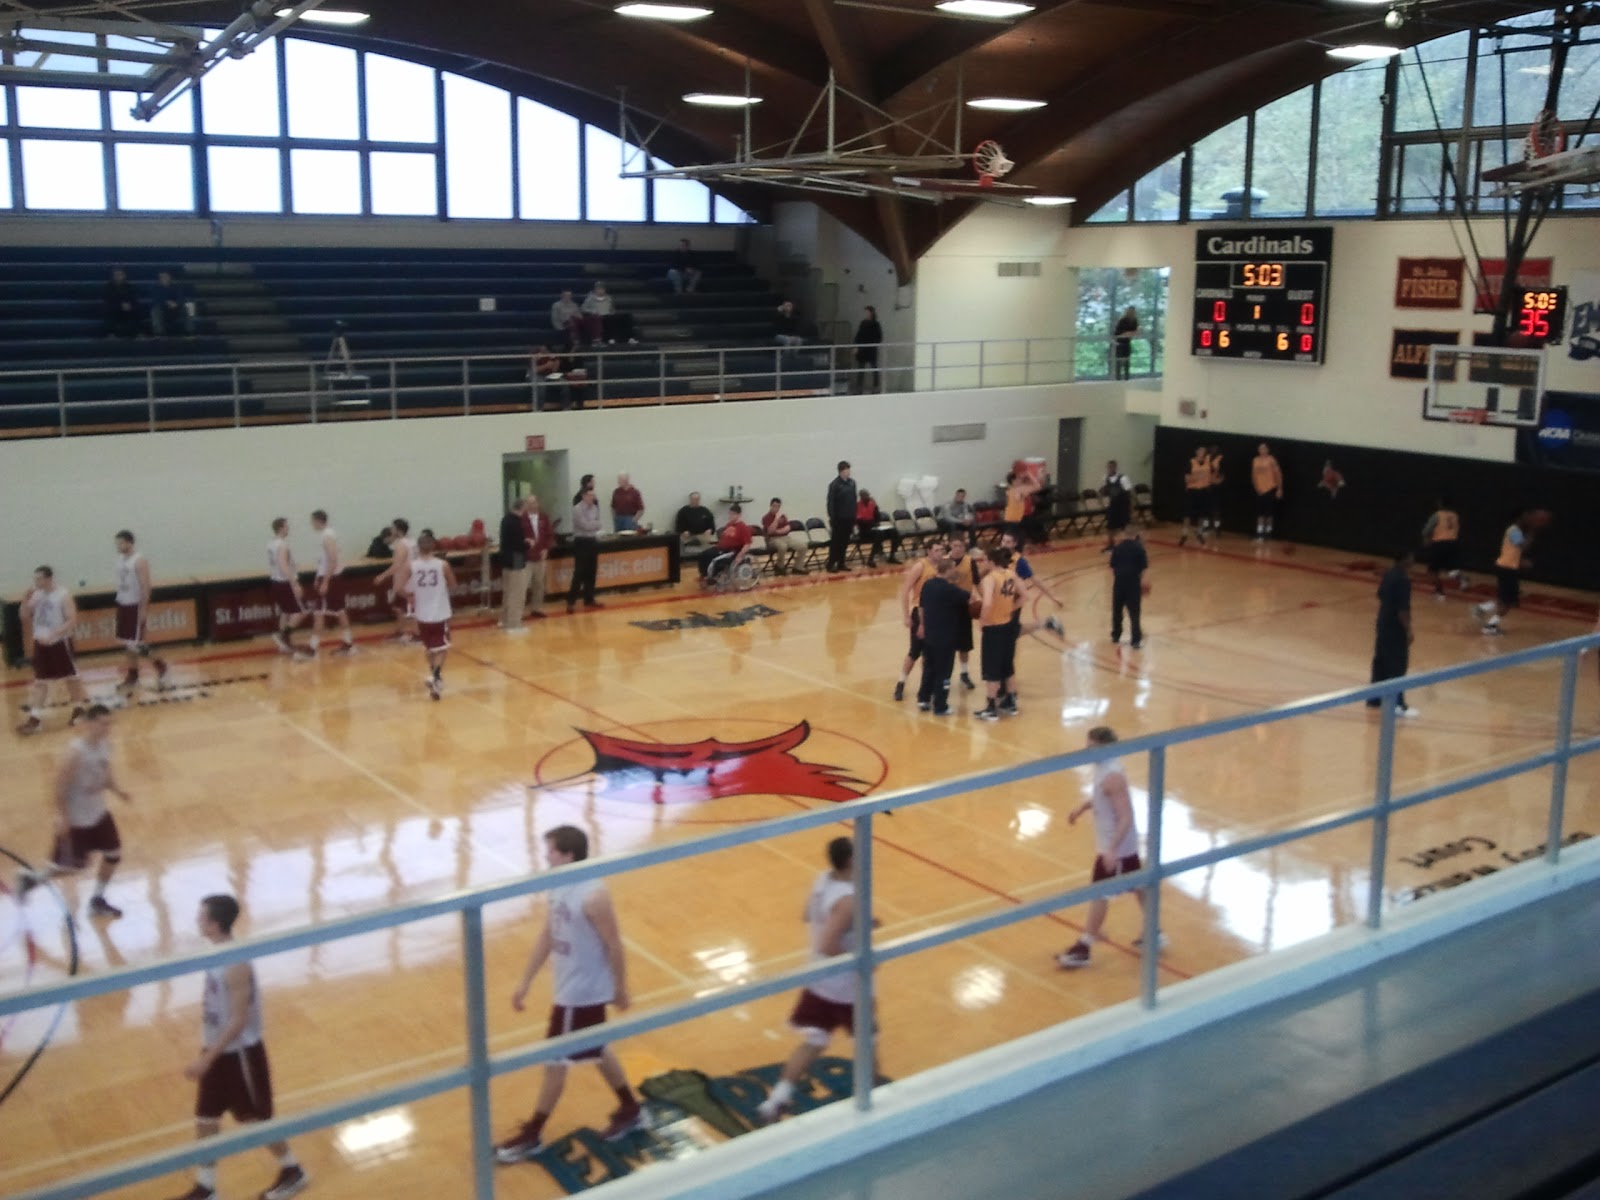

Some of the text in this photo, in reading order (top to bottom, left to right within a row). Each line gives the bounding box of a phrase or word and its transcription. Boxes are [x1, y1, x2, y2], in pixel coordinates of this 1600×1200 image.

[1207, 235, 1314, 255] Cardinals
[1243, 263, 1283, 286] 5:03
[1400, 278, 1458, 299] FISHER
[1519, 309, 1549, 336] 35
[1218, 330, 1230, 348] 6
[1277, 332, 1289, 350] 6
[417, 569, 438, 587] 23
